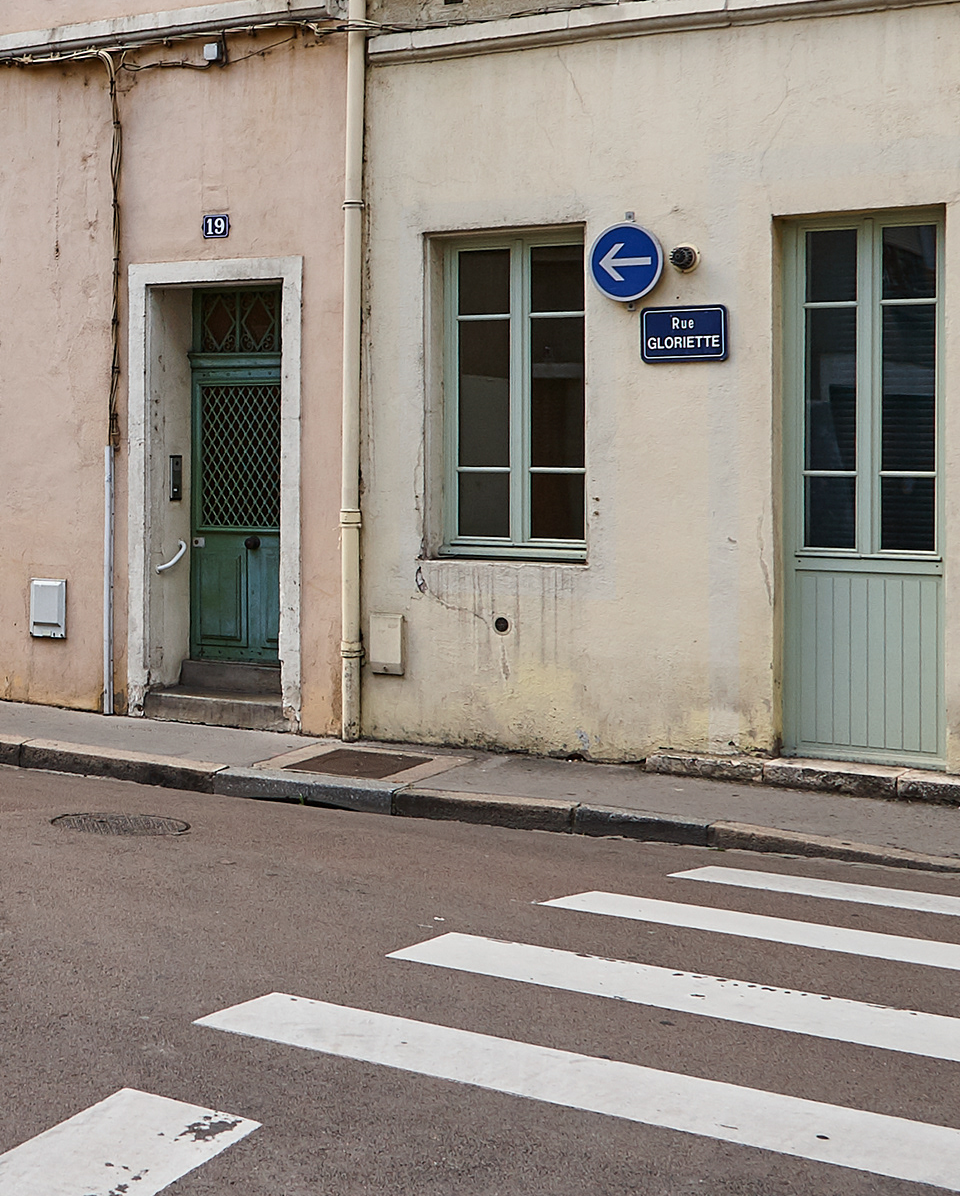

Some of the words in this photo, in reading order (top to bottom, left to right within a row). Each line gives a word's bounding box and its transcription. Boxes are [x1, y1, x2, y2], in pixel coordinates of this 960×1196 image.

[206, 217, 225, 235] 19
[672, 317, 695, 330] Rue
[647, 335, 721, 350] GLORIETTE
